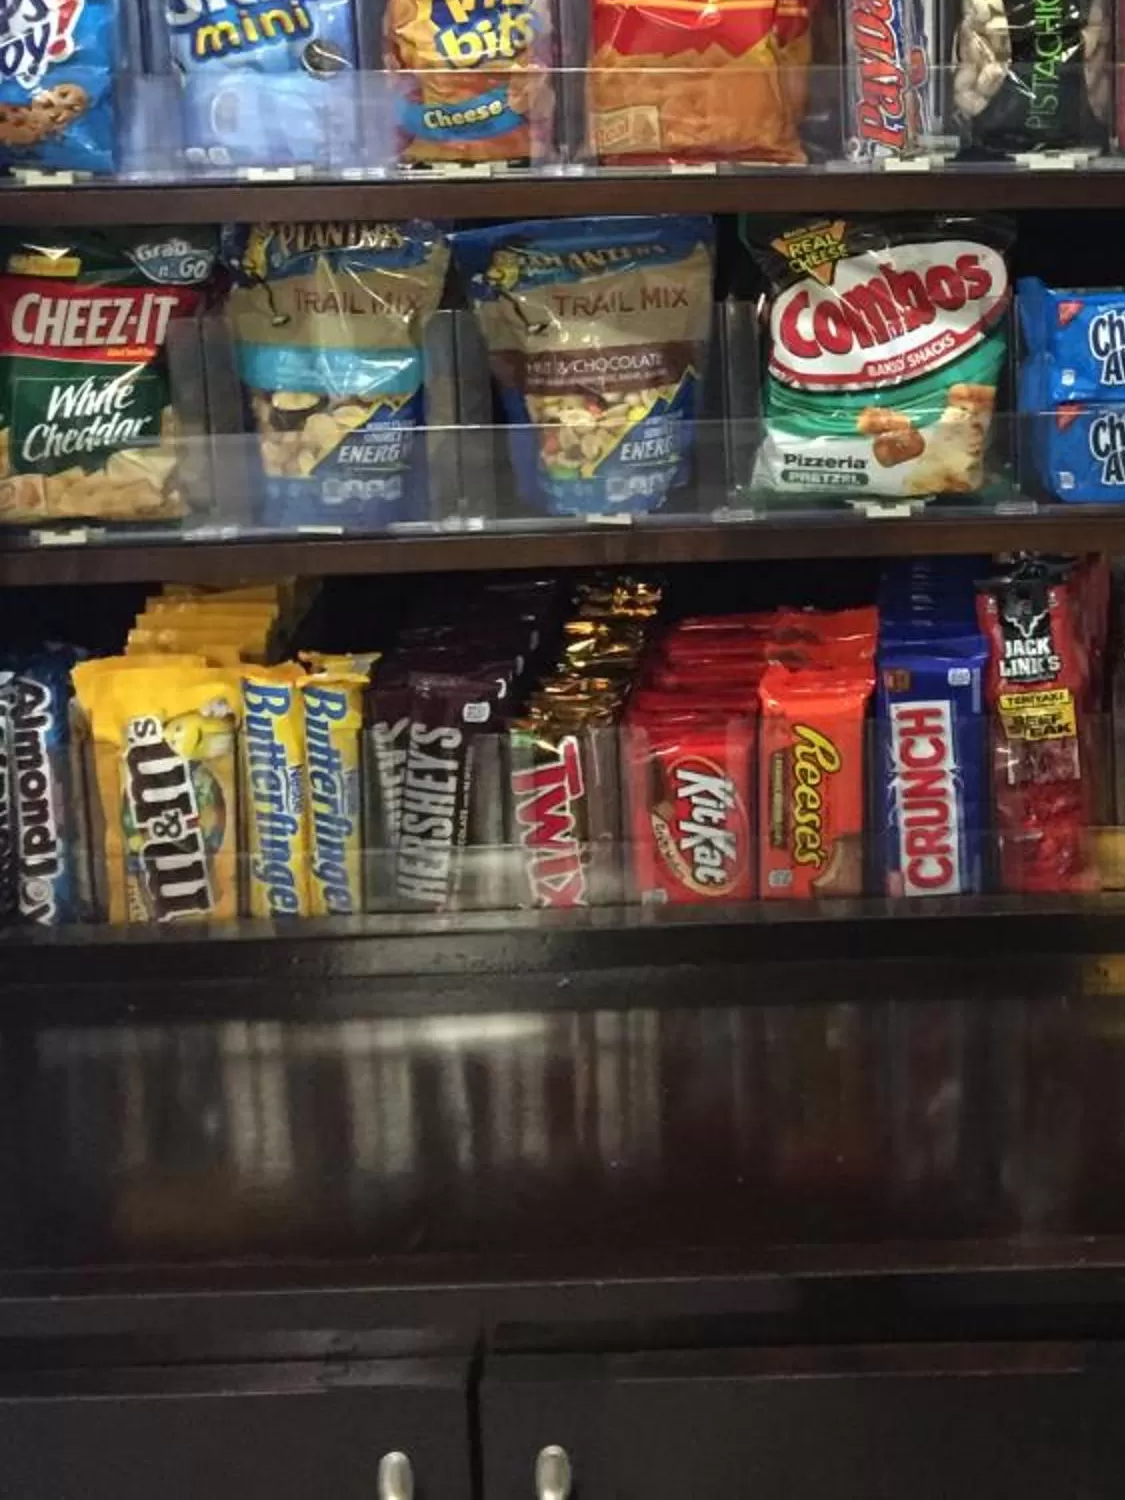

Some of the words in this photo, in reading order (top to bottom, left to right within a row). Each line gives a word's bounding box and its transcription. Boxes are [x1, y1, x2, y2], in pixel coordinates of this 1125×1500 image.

[441, 11, 536, 67] bits
[424, 100, 503, 128] Cheese
[136, 238, 188, 261] Grab
[787, 245, 849, 273] CHEESE
[789, 234, 838, 259] REAL
[179, 257, 208, 278] Go
[294, 288, 366, 315] TRAIL
[552, 291, 635, 317] TRAIL
[640, 285, 689, 311] MIX
[12, 292, 179, 347] CHEEZ-IT
[573, 353, 664, 373] CHOCOLATE
[907, 336, 956, 371] SNACKS
[46, 375, 136, 421] White
[22, 410, 153, 463] Cheddar
[784, 453, 868, 470] Pizzeria
[1005, 637, 1050, 658] JACK
[999, 656, 1061, 678] LINK'S
[1006, 692, 1065, 704] TERIYAKI
[13, 677, 58, 856] Almond
[303, 686, 353, 914] Butterfinge
[397, 722, 463, 903] HERSHEY'S
[792, 723, 842, 870] Reese's
[895, 707, 955, 889] CRUNCH
[511, 735, 588, 909] TWIX
